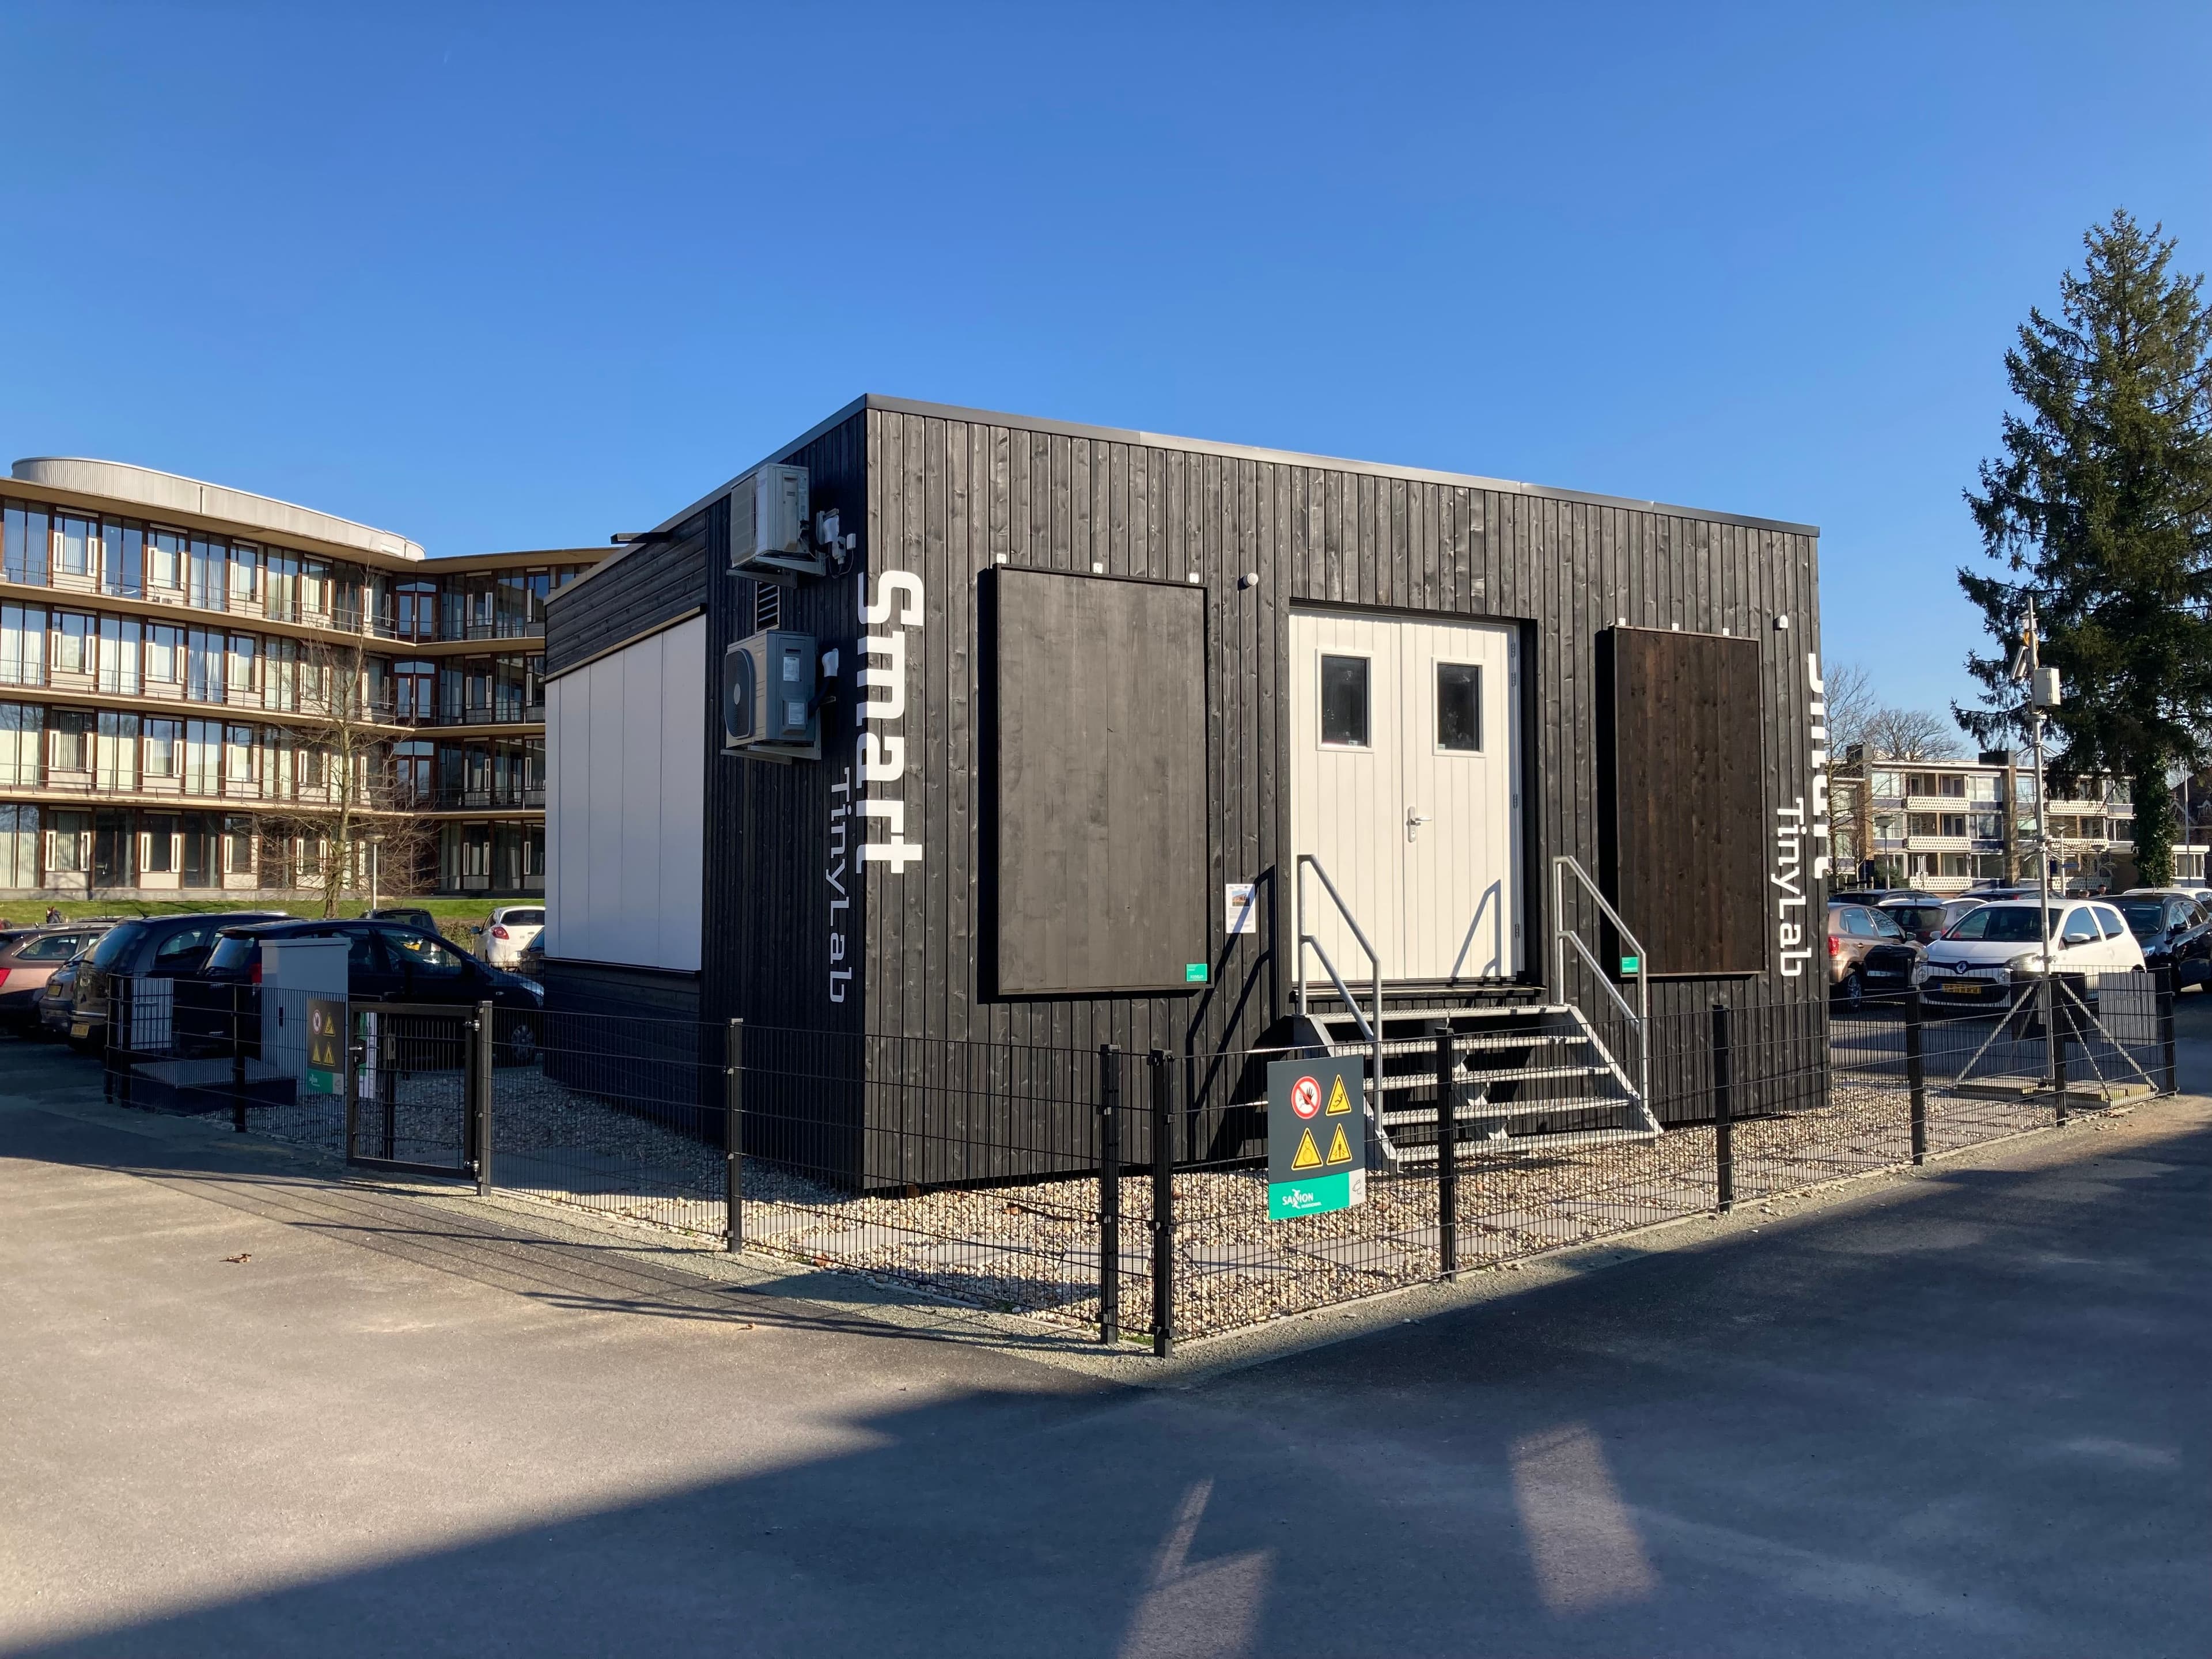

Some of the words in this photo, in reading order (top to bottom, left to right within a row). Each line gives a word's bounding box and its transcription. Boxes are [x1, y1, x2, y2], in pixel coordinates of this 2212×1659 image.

[856, 570, 924, 874] Smart
[825, 767, 853, 1003] TinyLab
[1771, 796, 1812, 977] TinyLab
